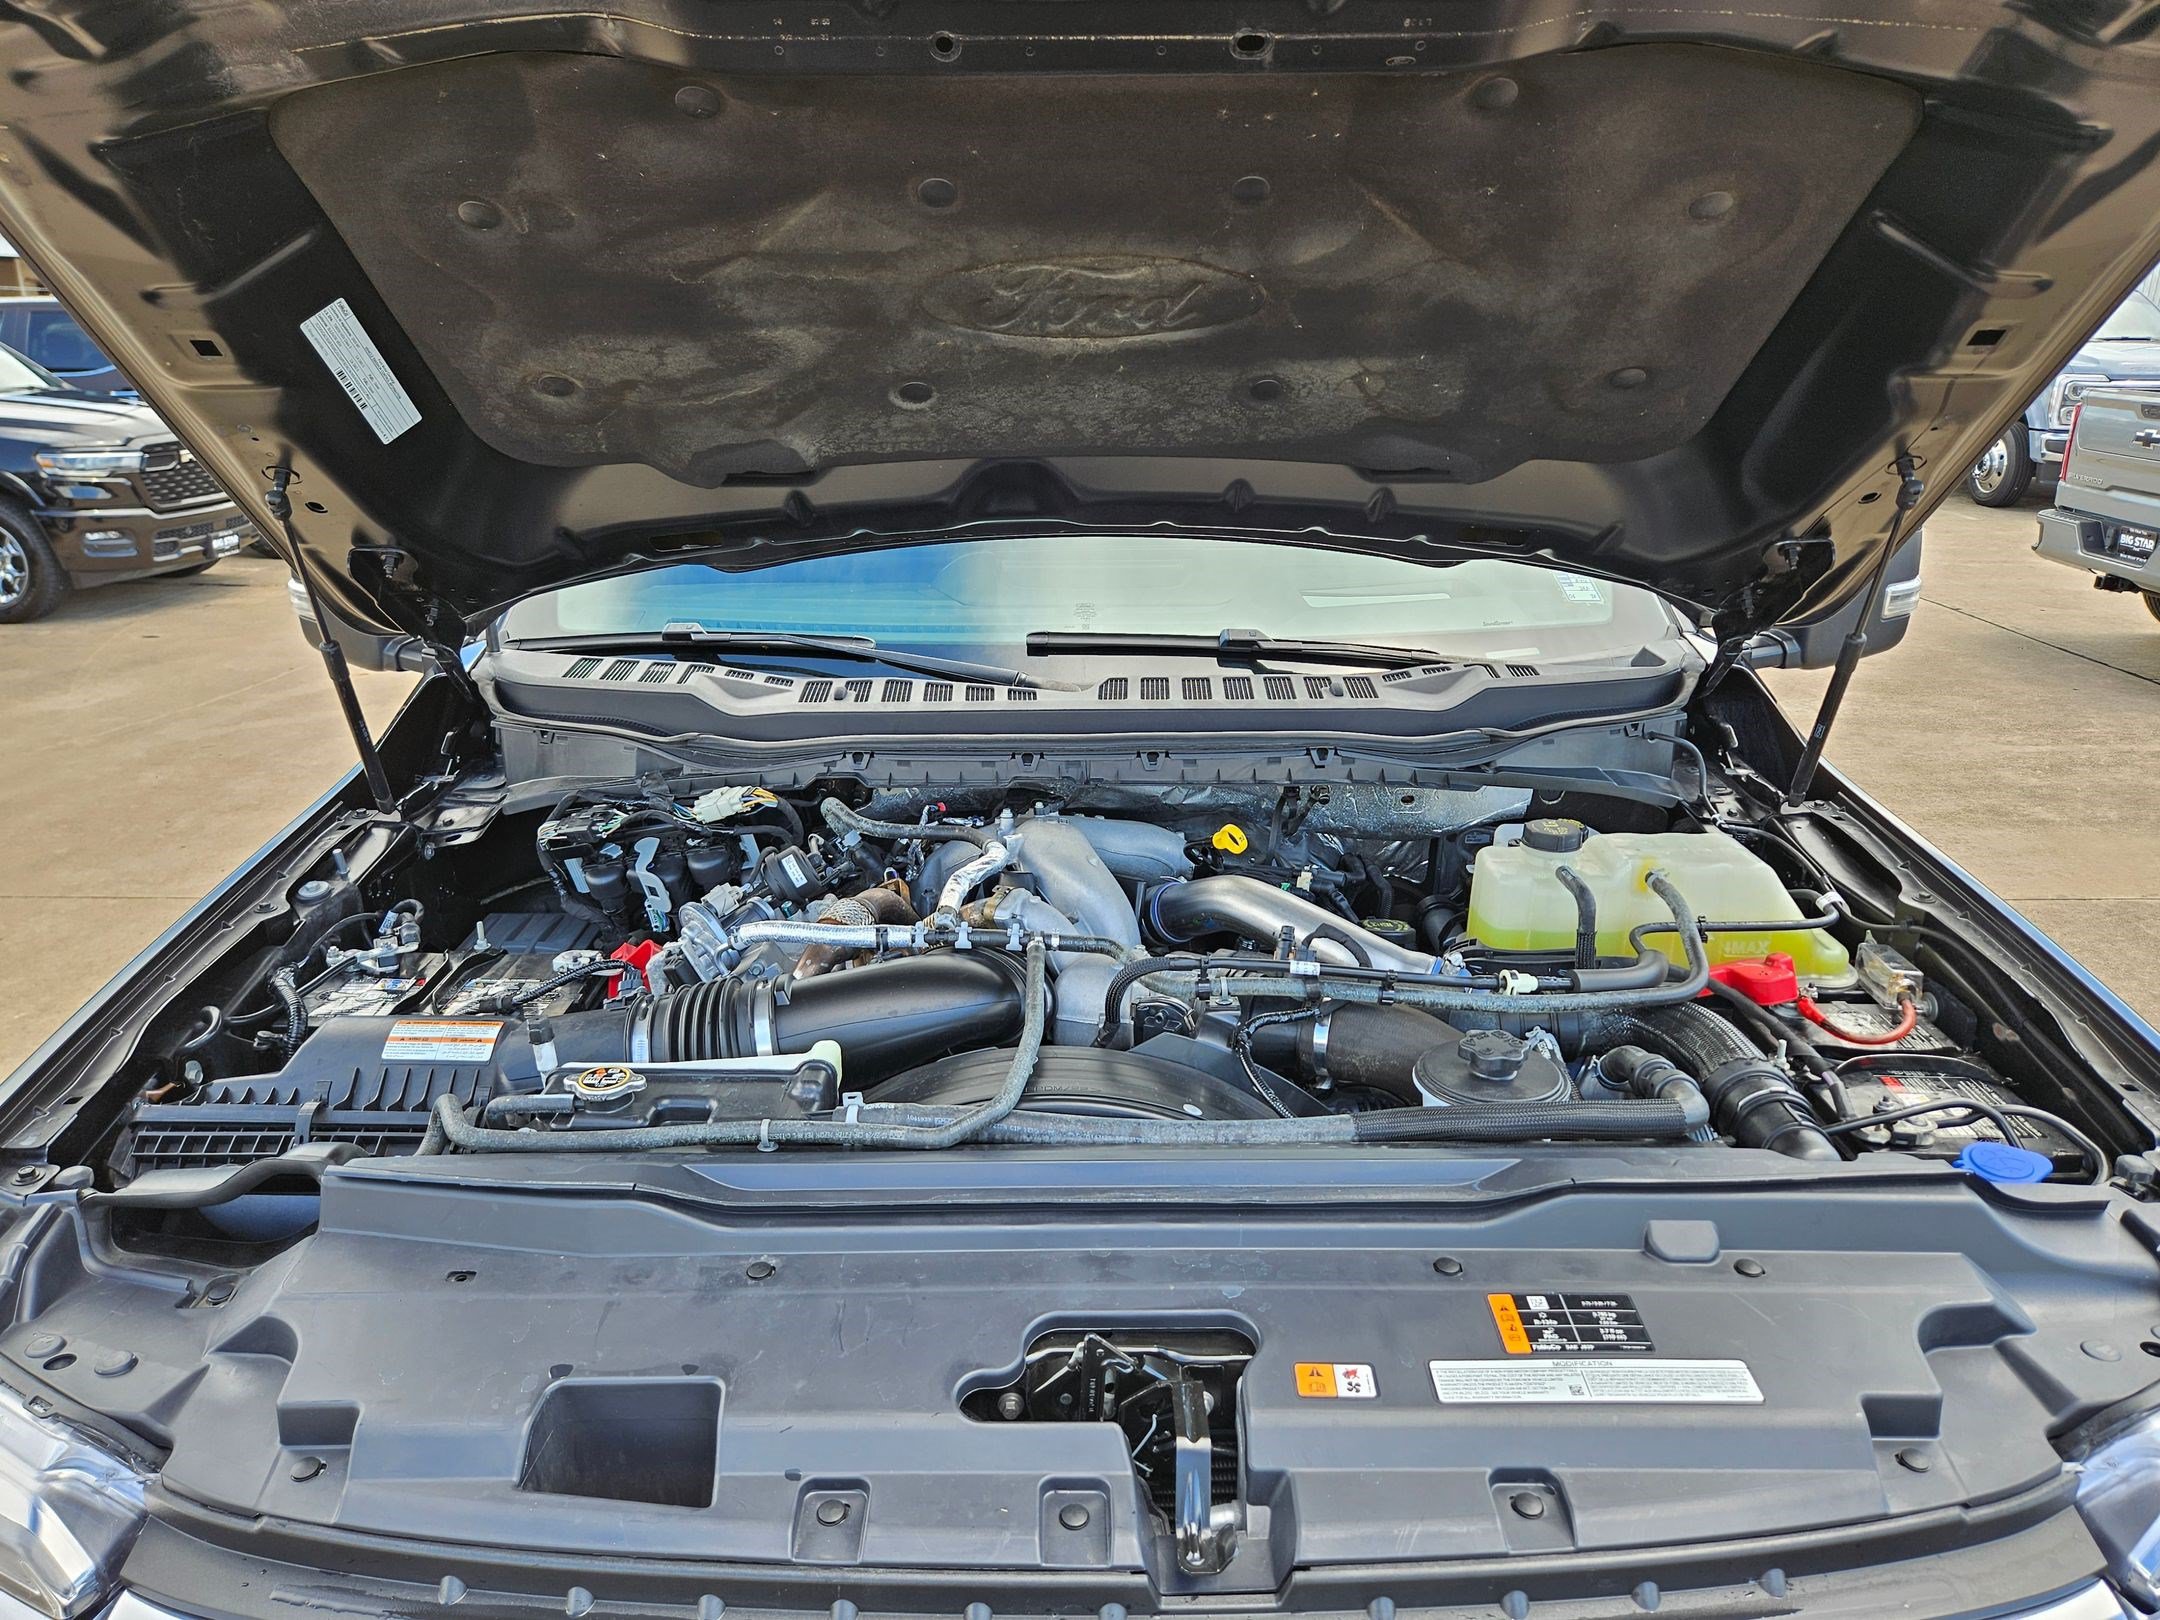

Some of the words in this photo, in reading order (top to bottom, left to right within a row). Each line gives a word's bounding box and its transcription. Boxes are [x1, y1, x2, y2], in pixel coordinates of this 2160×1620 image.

[977, 263, 1202, 330] Ford
[2120, 534, 2134, 545] BIG
[2135, 536, 2155, 550] STAR
